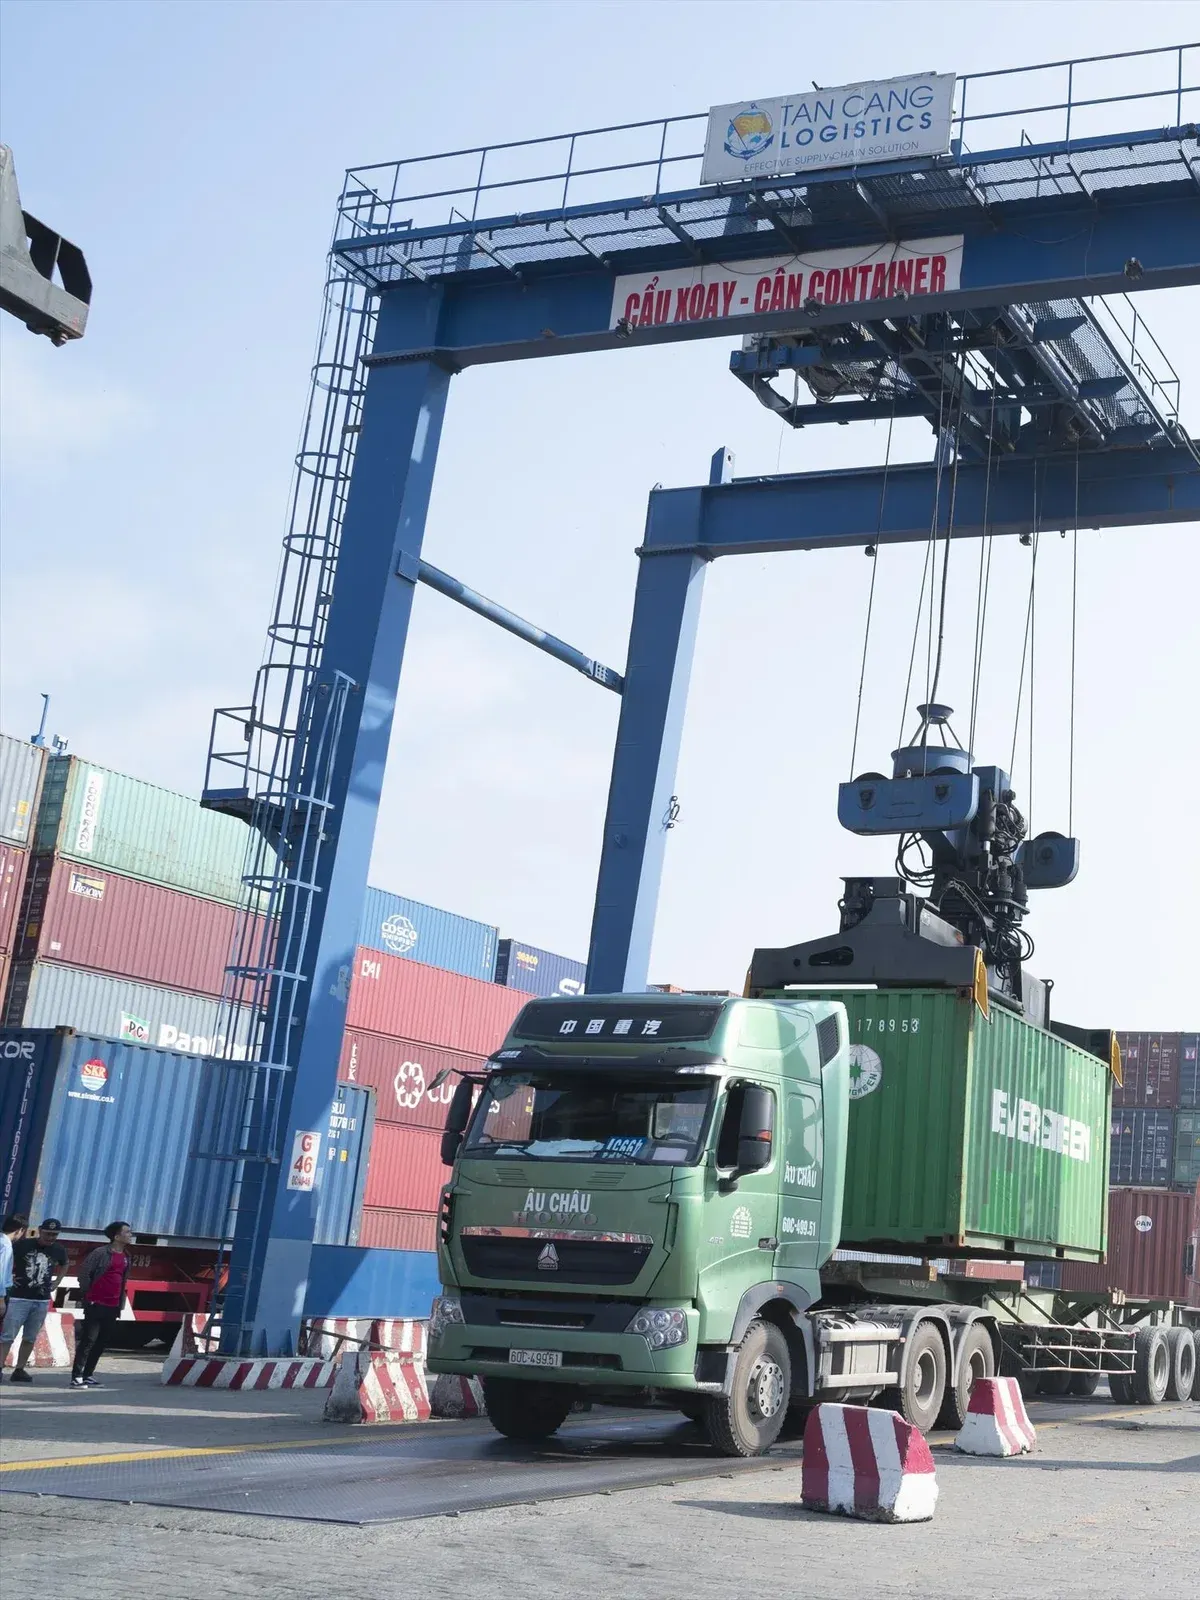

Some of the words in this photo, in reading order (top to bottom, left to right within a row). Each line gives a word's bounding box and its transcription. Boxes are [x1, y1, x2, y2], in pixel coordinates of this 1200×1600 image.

[780, 99, 834, 126] TAN
[842, 85, 934, 117] CANG
[781, 111, 932, 148] LOGISTICS
[744, 157, 792, 172] EFFECTIVE
[867, 141, 919, 156] SOLUTION
[623, 276, 672, 325] CẨU
[672, 280, 737, 323] XOAY
[753, 266, 803, 314] CÂN
[806, 255, 947, 305] CONTAINER
[382, 922, 417, 941] COSCO
[558, 1019, 663, 1035] 中国重汽
[83, 1064, 107, 1078] SKR
[301, 1134, 313, 1153] G
[294, 1155, 313, 1174] 46
[523, 1187, 546, 1212] ÂU
[549, 1190, 591, 1213] CHÂU
[511, 1211, 599, 1226] HOWO
[1136, 1220, 1152, 1228] PAN
[510, 1351, 559, 1366] 60C-499.51
